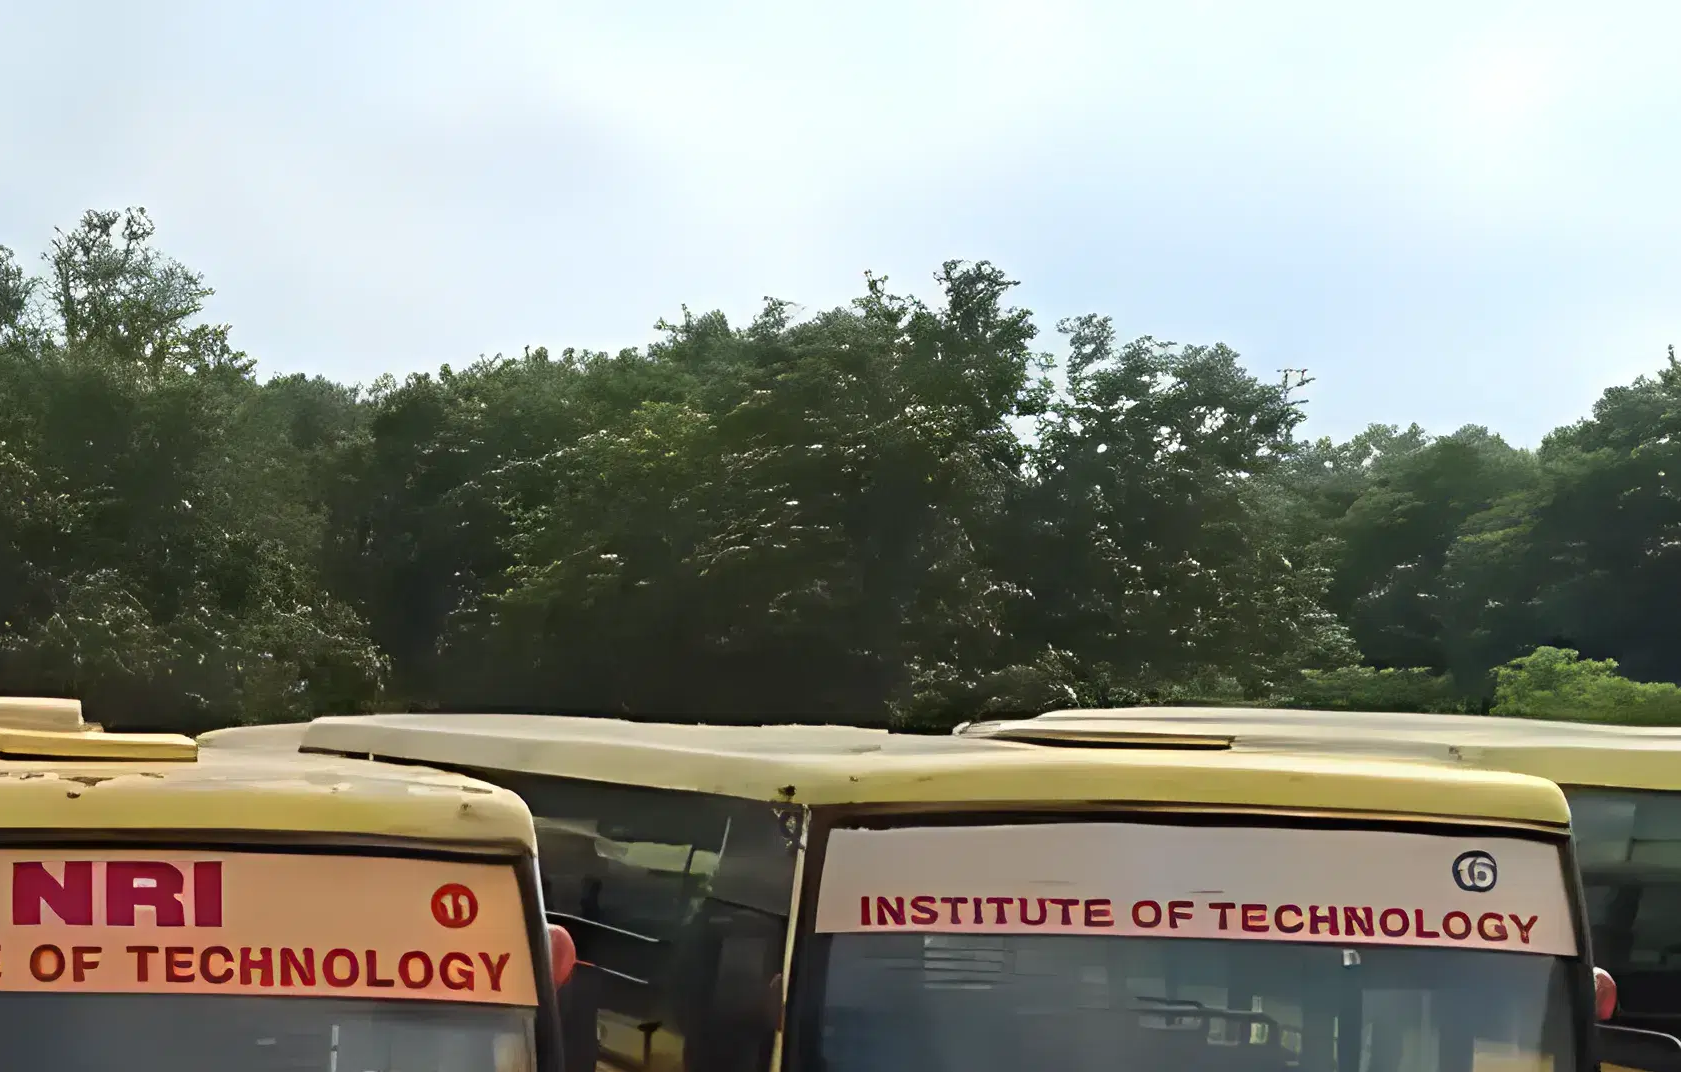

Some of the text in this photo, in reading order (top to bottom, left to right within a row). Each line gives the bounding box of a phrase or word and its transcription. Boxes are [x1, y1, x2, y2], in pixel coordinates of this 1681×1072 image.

[12, 861, 223, 927] NRI
[440, 893, 470, 920] 11
[860, 896, 1539, 945] INSTITUTE OF TECHNOLOGY
[30, 944, 102, 982] OF
[126, 945, 511, 992] TECHNOLOGY
